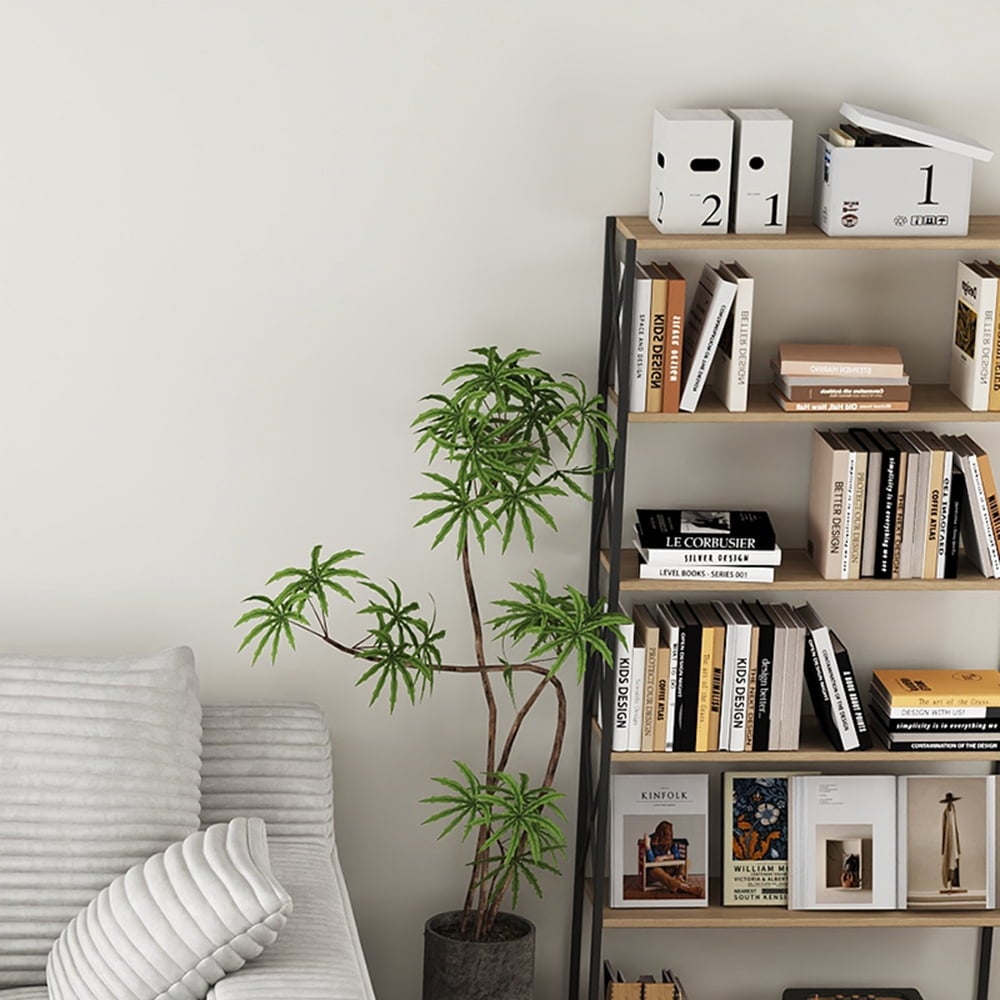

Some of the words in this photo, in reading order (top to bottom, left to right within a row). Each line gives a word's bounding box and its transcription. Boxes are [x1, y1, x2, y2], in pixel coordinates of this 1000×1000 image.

[918, 164, 939, 206] 1
[701, 194, 722, 226] 2
[764, 194, 782, 226] 1
[833, 482, 844, 516] BETTER
[930, 490, 939, 516] COFFEE
[666, 537, 682, 548] LE
[684, 536, 756, 549] CORBUSIER
[830, 517, 842, 554] DESIGN
[928, 518, 937, 541] ATLAS
[684, 554, 714, 562] SILVER
[619, 657, 630, 684] KIDS
[736, 657, 748, 684] KIDS
[758, 658, 770, 686] design
[616, 686, 628, 729] DESIGN
[657, 702, 666, 720] ATLAS
[734, 686, 746, 729] DESIGN
[896, 722, 931, 730] simplicity
[950, 722, 986, 730] everything
[640, 792, 688, 800] KINFOLK
